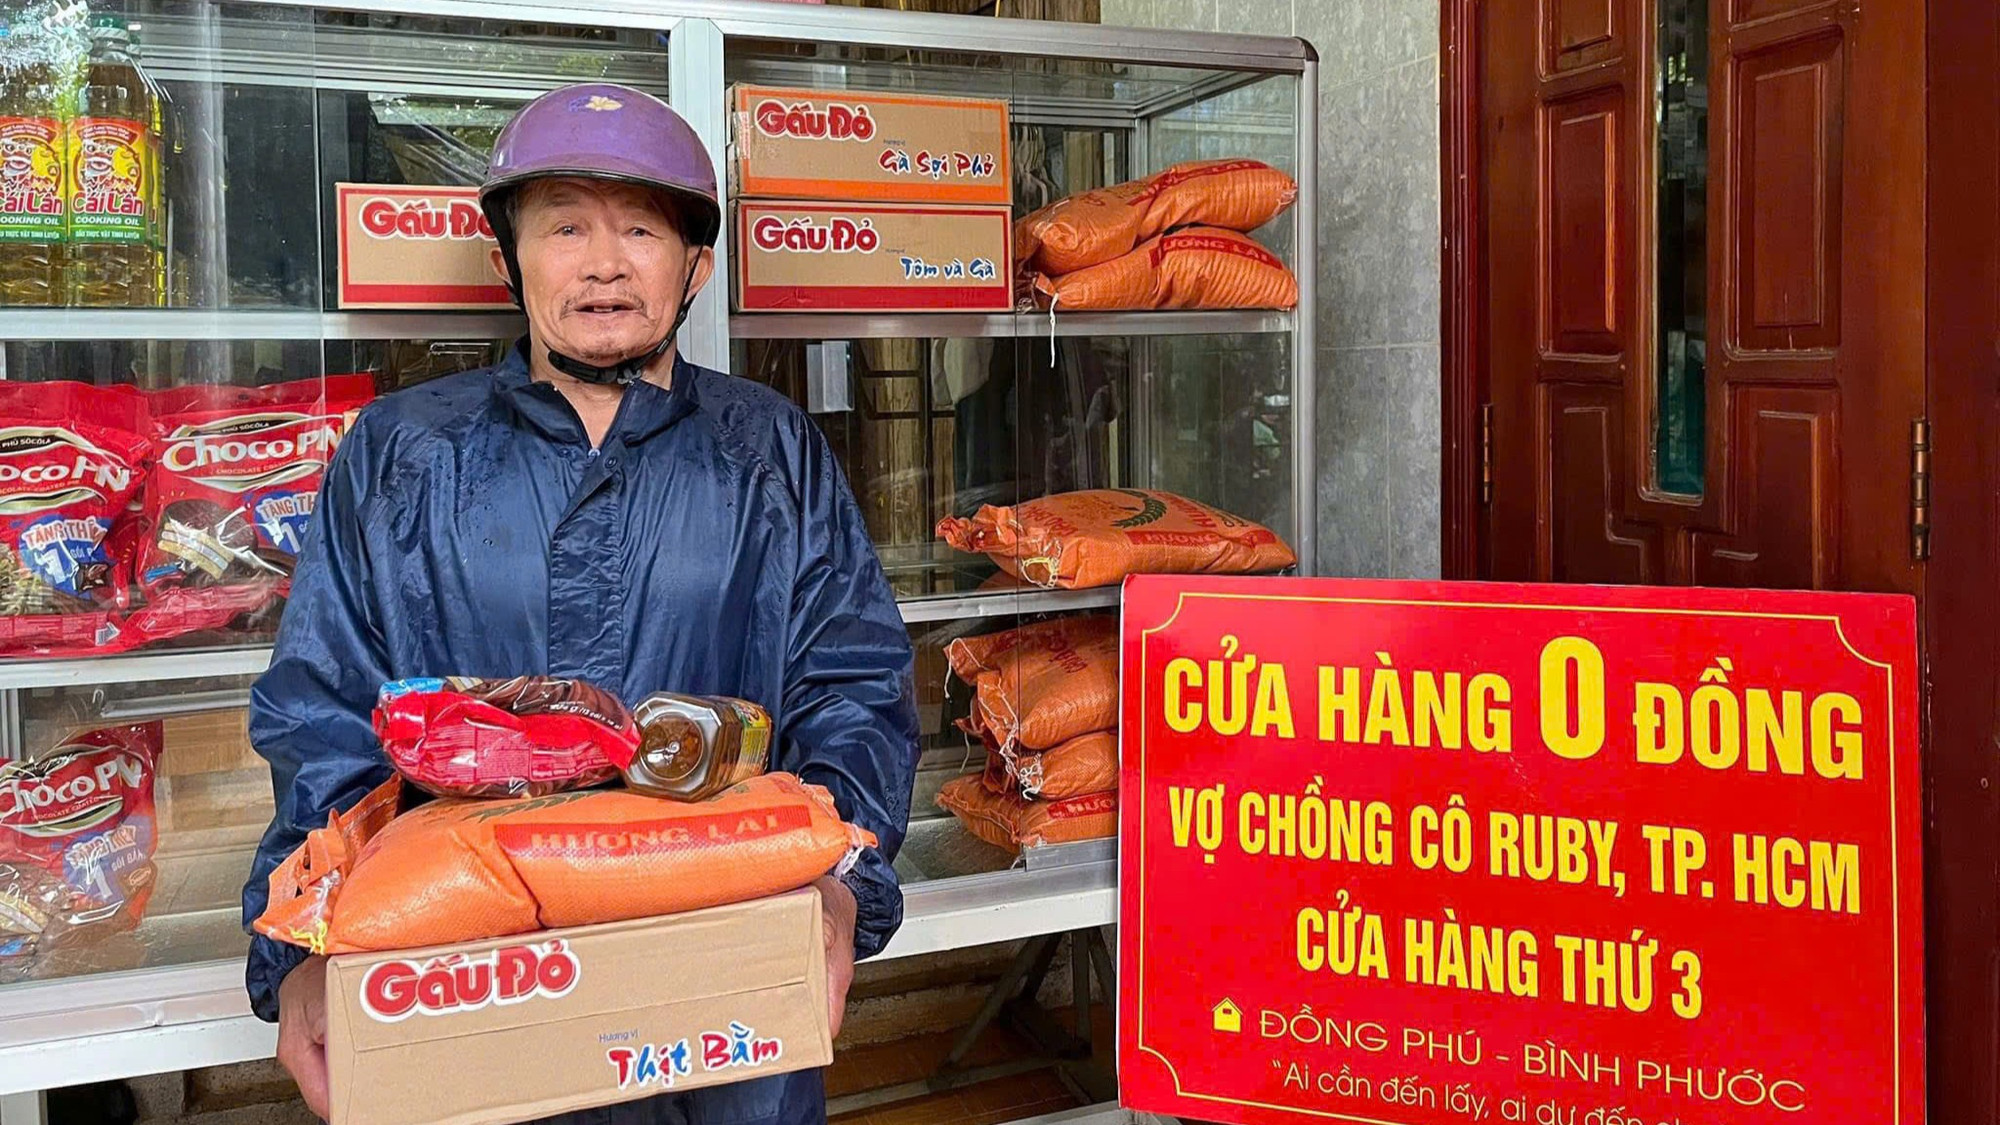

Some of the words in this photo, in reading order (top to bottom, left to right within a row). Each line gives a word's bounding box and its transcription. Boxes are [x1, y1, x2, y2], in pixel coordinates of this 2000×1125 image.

[879, 149, 910, 174] Gà
[916, 150, 946, 178] Sợi
[955, 152, 995, 176] Phở
[44, 217, 60, 226] OIL
[75, 216, 122, 225] COOKING
[124, 217, 140, 226] OIL
[900, 256, 938, 278] Tôm
[944, 259, 963, 278] và
[969, 257, 995, 279] Gà
[1164, 633, 1295, 739] CỬA
[1318, 651, 1512, 754] HÀNG
[1632, 657, 1864, 781] ĐỒNG
[1168, 783, 1225, 864] VỢ
[1238, 775, 1393, 866] CHỒNG
[1410, 794, 1472, 874] CÔ
[1489, 811, 1626, 898] RUBY,
[1642, 824, 1714, 898] TP.
[1733, 833, 1860, 915] HCM
[364, 952, 484, 1017] Gấu
[494, 937, 580, 1001] Đỏ
[1296, 888, 1391, 980] CỬA
[1405, 908, 1540, 998] HÀNG
[1554, 929, 1659, 1013] THỨ
[1671, 950, 1703, 1020] 3
[599, 1031, 629, 1044] Hương
[608, 1039, 690, 1087] Thịt
[701, 1022, 780, 1069] Bằm
[1259, 1002, 1389, 1053] ĐỒNG
[1402, 1028, 1483, 1067] PHÚ
[1522, 1038, 1622, 1087] BÌNH
[1637, 1059, 1808, 1113] PHƯỚC
[1316, 1063, 1373, 1100] cần
[1379, 1074, 1437, 1109] đến
[1444, 1083, 1492, 1122] lấy,
[1501, 1096, 1527, 1123] ai
